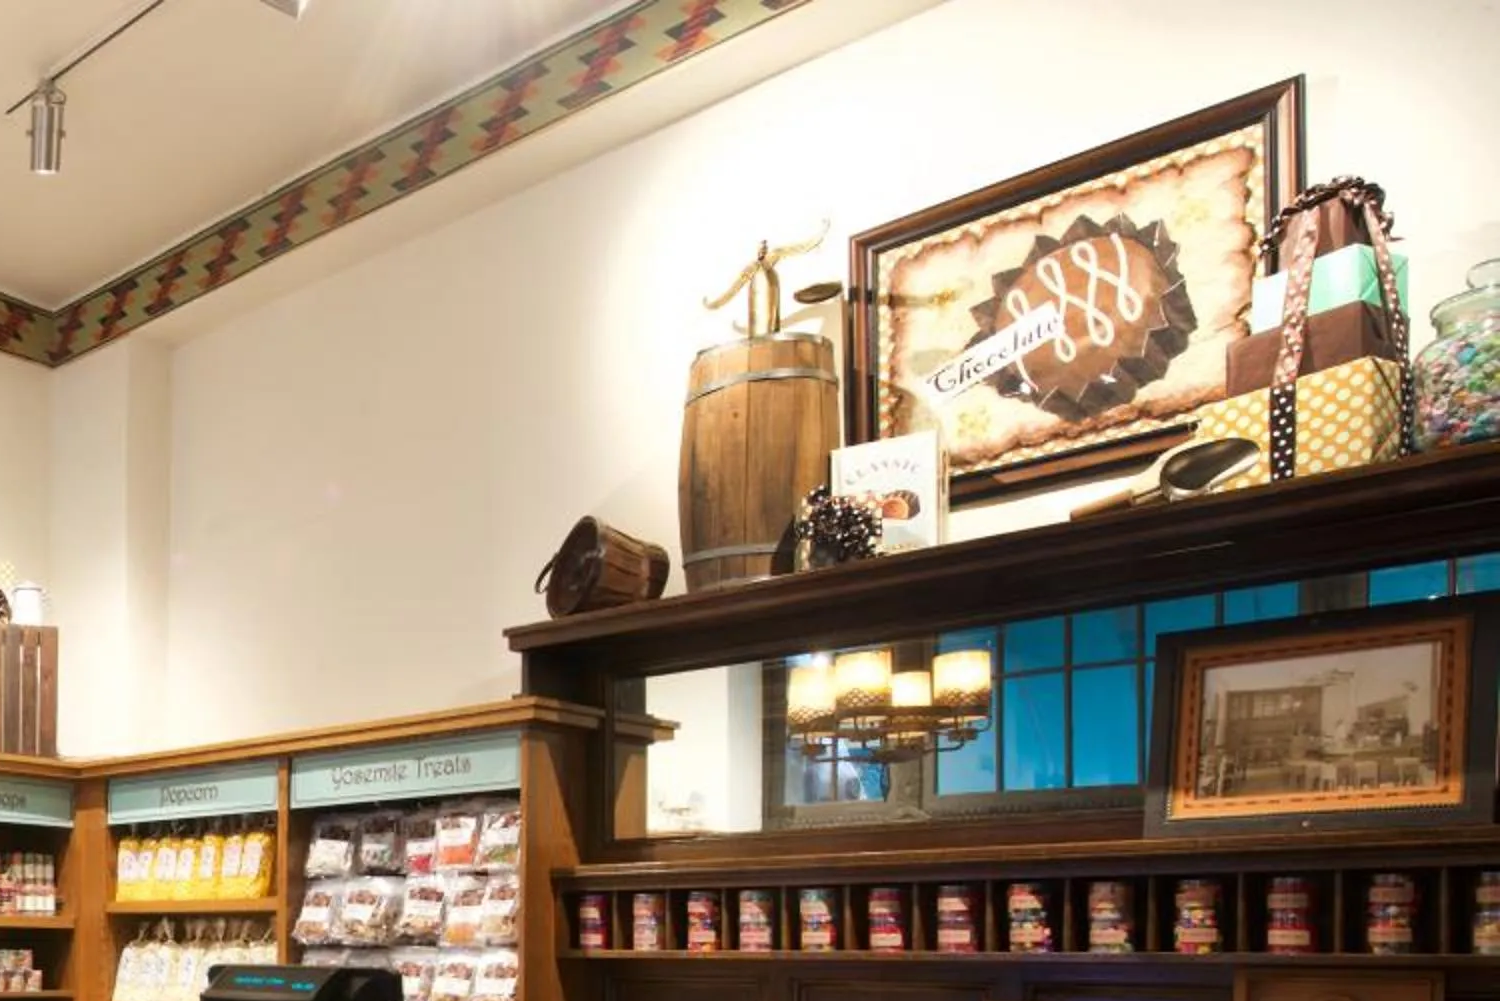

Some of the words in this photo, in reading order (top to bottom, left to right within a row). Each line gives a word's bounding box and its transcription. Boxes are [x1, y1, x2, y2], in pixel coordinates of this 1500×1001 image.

[926, 316, 1059, 393] Chocolate
[331, 763, 407, 790] Yosemite
[415, 755, 471, 779] Treats
